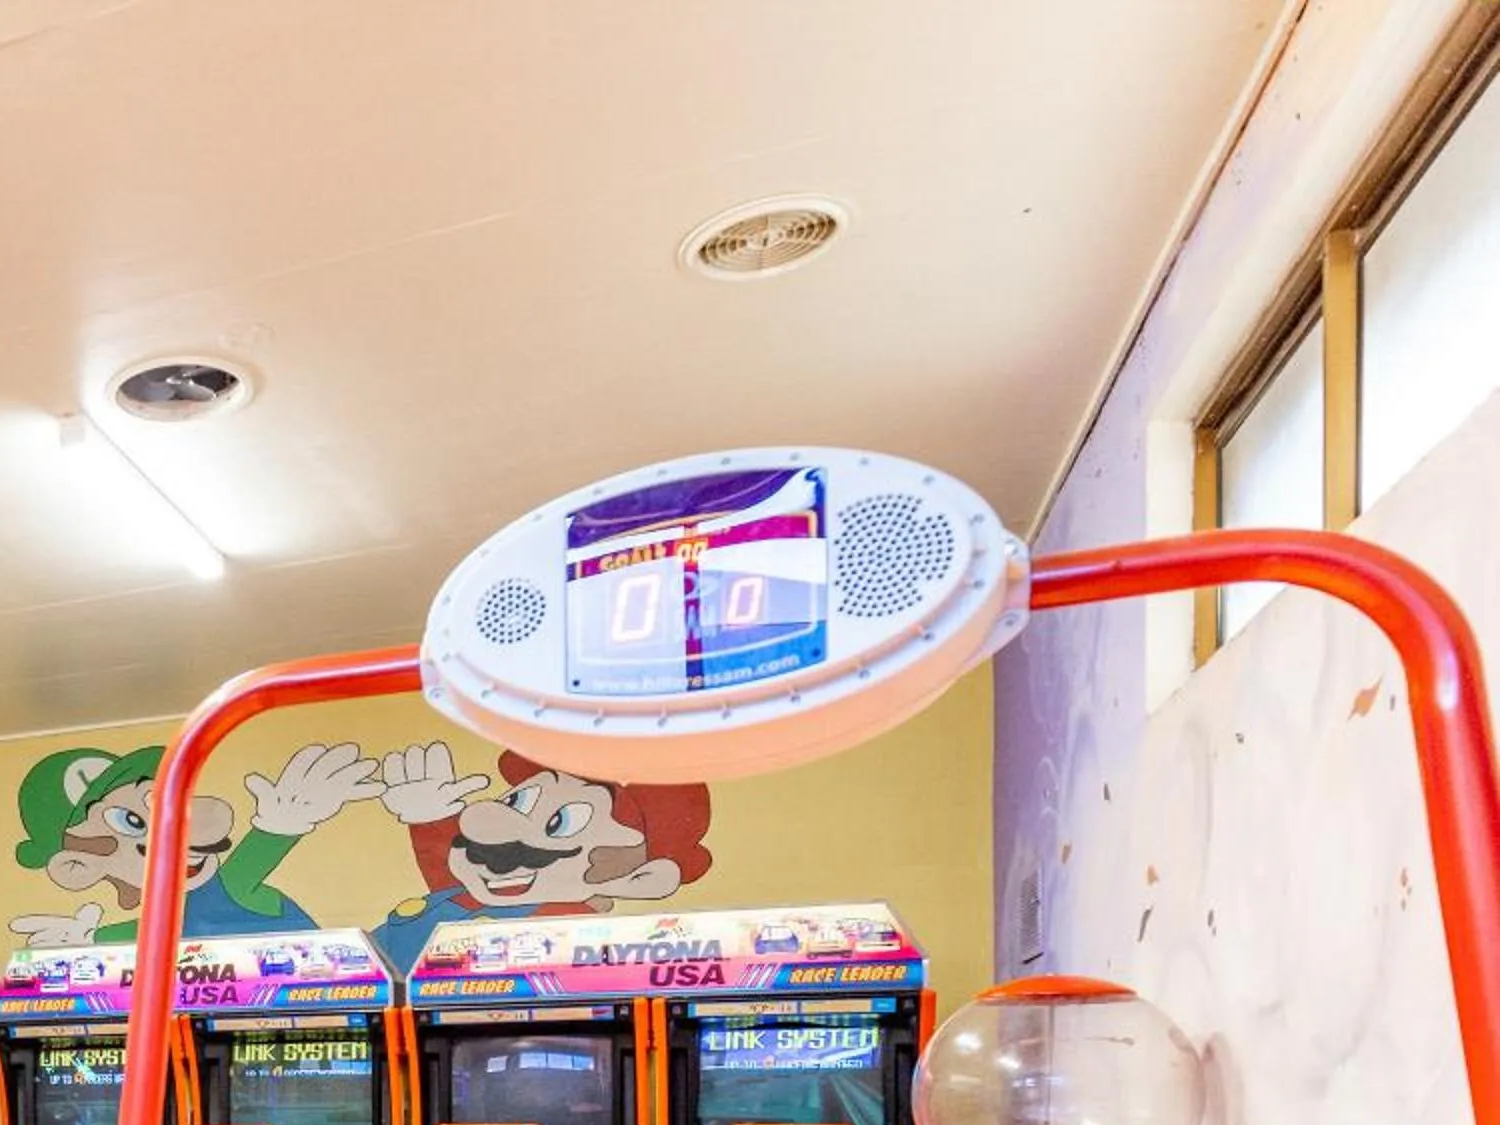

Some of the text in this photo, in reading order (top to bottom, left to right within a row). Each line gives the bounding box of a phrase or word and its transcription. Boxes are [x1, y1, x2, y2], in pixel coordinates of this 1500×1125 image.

[571, 939, 723, 966] DAYTONA
[650, 964, 725, 986] USA
[790, 965, 907, 984] RACE LEADER
[181, 985, 239, 1004] USA
[288, 985, 377, 1001] RACE LEADER
[420, 979, 515, 996] RACE LEADER
[33, 998, 75, 1012] LEADER
[709, 1027, 879, 1050] LINK SYSTEM
[39, 1048, 126, 1068] LINK SYST
[233, 1042, 367, 1063] LINK SYSTEM
